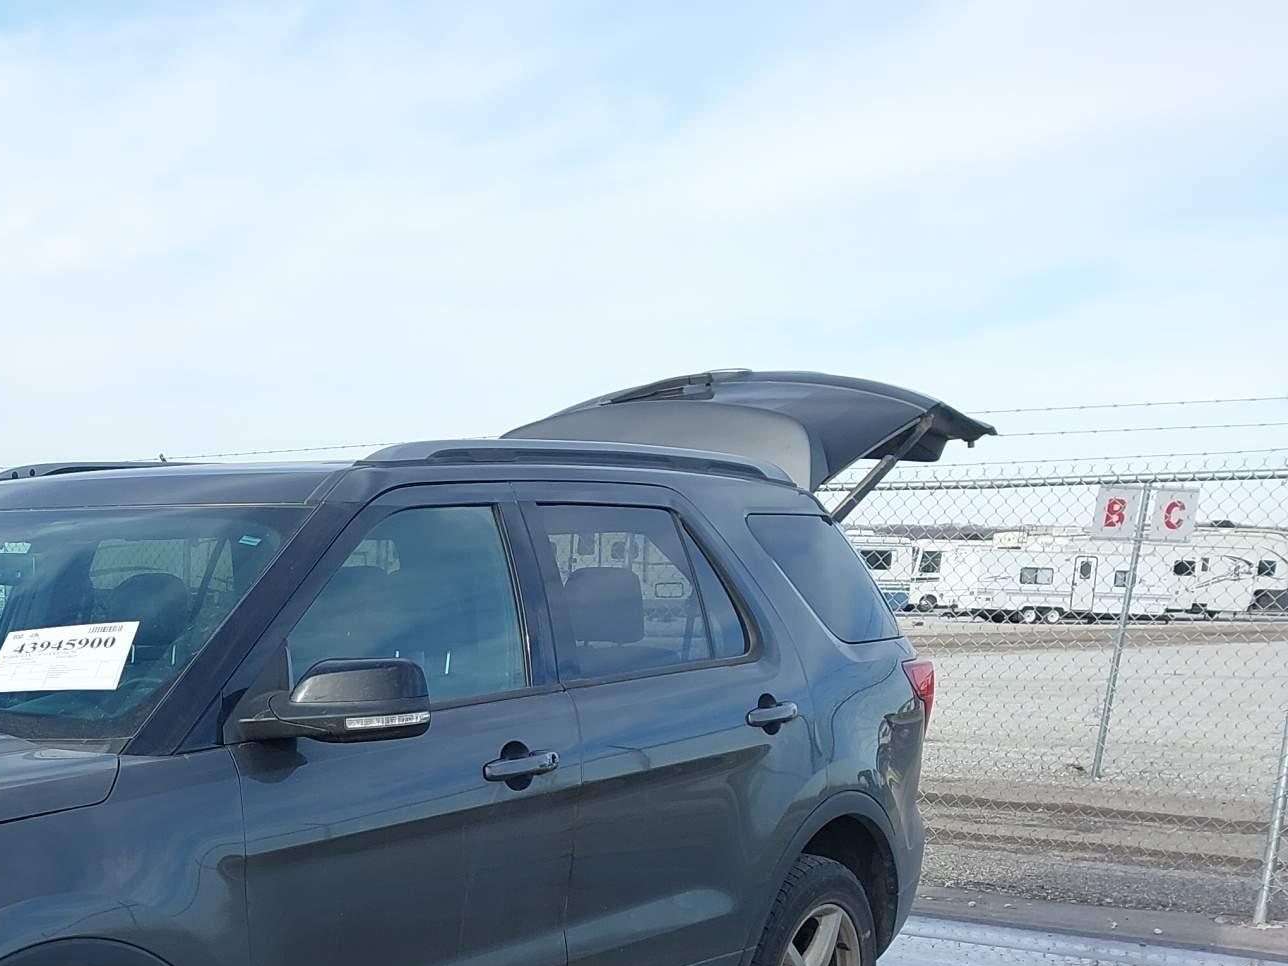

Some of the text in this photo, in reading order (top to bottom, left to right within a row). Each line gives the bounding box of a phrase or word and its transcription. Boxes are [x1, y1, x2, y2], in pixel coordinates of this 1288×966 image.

[1104, 497, 1127, 527] B
[1164, 500, 1187, 530] C
[13, 635, 117, 655] 43945900
